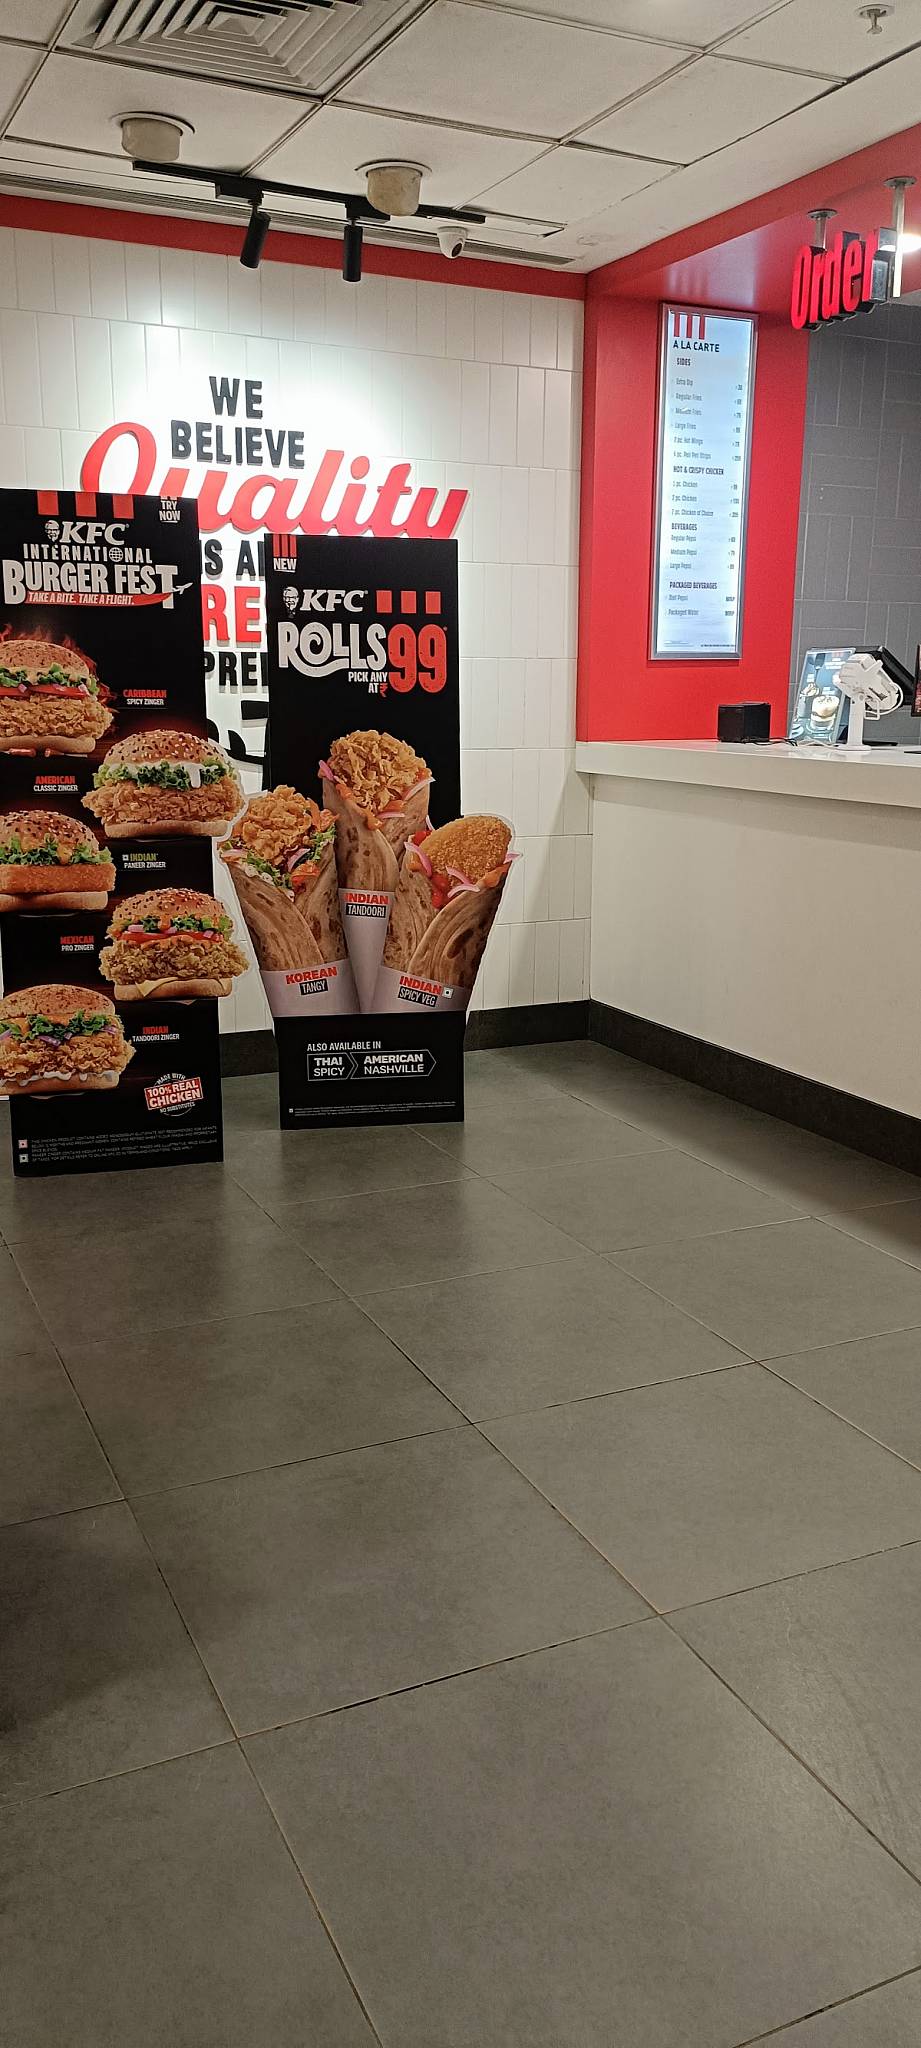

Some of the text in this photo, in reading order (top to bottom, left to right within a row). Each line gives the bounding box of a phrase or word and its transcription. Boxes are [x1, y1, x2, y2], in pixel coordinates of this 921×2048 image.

[673, 340, 720, 352] A LA CARTE
[676, 358, 691, 366] SIDES
[209, 376, 263, 419] WE
[171, 419, 305, 469] BELIEVE
[673, 465, 683, 473] HOT
[689, 466, 705, 475] CRISPY
[706, 467, 724, 475] CHICKEN
[80, 421, 469, 538] Quality
[161, 500, 177, 510] TRY
[159, 511, 181, 521] NOW
[671, 523, 697, 531] BEVERAGES
[60, 521, 126, 545] KFC
[200, 539, 223, 576] S
[273, 558, 297, 570] NEW
[2, 560, 178, 609] BURGER FEST
[669, 581, 717, 590] PACKAGED BEVERAGES
[29, 592, 135, 605] TAKE A BITE. TAKE A FLIGHT.
[300, 589, 365, 612] KFC
[278, 622, 447, 693] ROLLS 99
[349, 672, 388, 682] PICK ANY
[369, 683, 378, 693] AT
[123, 690, 167, 698] CARIBBEAN
[35, 776, 76, 784] AMERICAN
[344, 893, 389, 904] INDIAN
[348, 905, 385, 916] TANDOORI
[60, 936, 95, 944] MEXICAN
[286, 966, 338, 985] KOREAN
[302, 979, 327, 994] TANGY
[399, 975, 442, 995] INDIAN
[399, 988, 436, 1006] SPICY VEG
[142, 1026, 169, 1034] INDIAN
[160, 1033, 180, 1041] ZINGER
[307, 1041, 381, 1051] ALSO AVAILABLE IN
[314, 1057, 343, 1066] THAI
[363, 1054, 423, 1065] AMERICAN
[313, 1067, 345, 1077] SPICY
[364, 1064, 424, 1075] NASHVILLE
[147, 1080, 199, 1098] 100% REAL
[149, 1089, 201, 1108] CHICKEN
